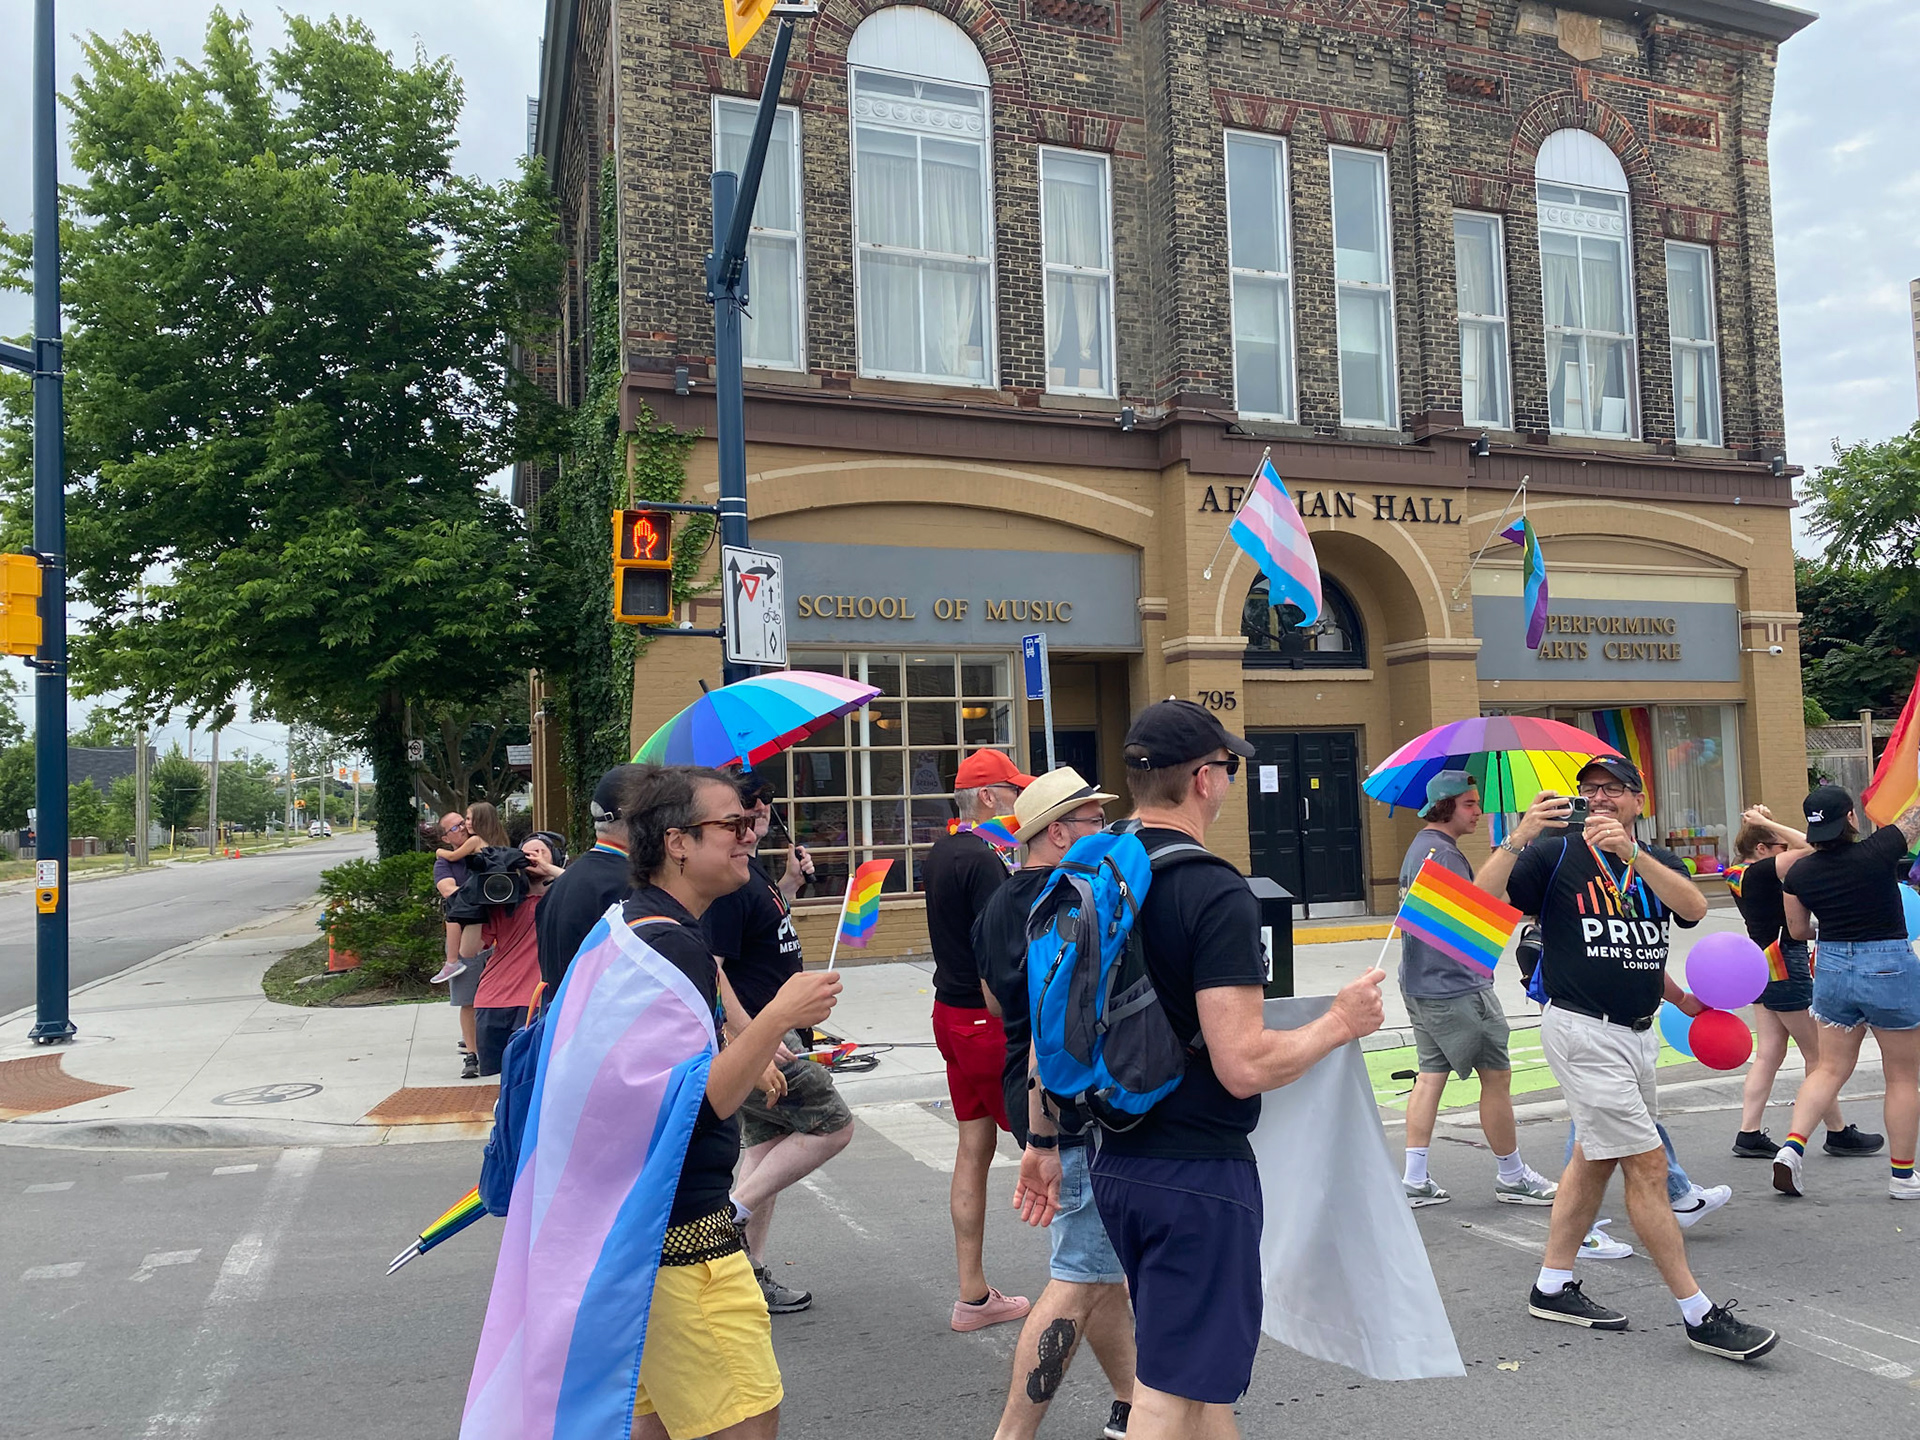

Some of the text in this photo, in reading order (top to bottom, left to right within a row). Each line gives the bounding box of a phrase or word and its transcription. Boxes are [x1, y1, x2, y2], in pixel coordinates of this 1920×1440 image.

[1560, 18, 1598, 47] 1884
[1198, 485, 1462, 524] AEIAN HALL
[798, 594, 1073, 623] SCHOOL OF MUSIC
[1547, 614, 1677, 635] PERFORMING
[1538, 640, 1682, 661] ARTS CENTRE
[1198, 690, 1237, 710] 795
[1586, 946, 1633, 959] MEN'S
[1623, 961, 1660, 970] LONDON
